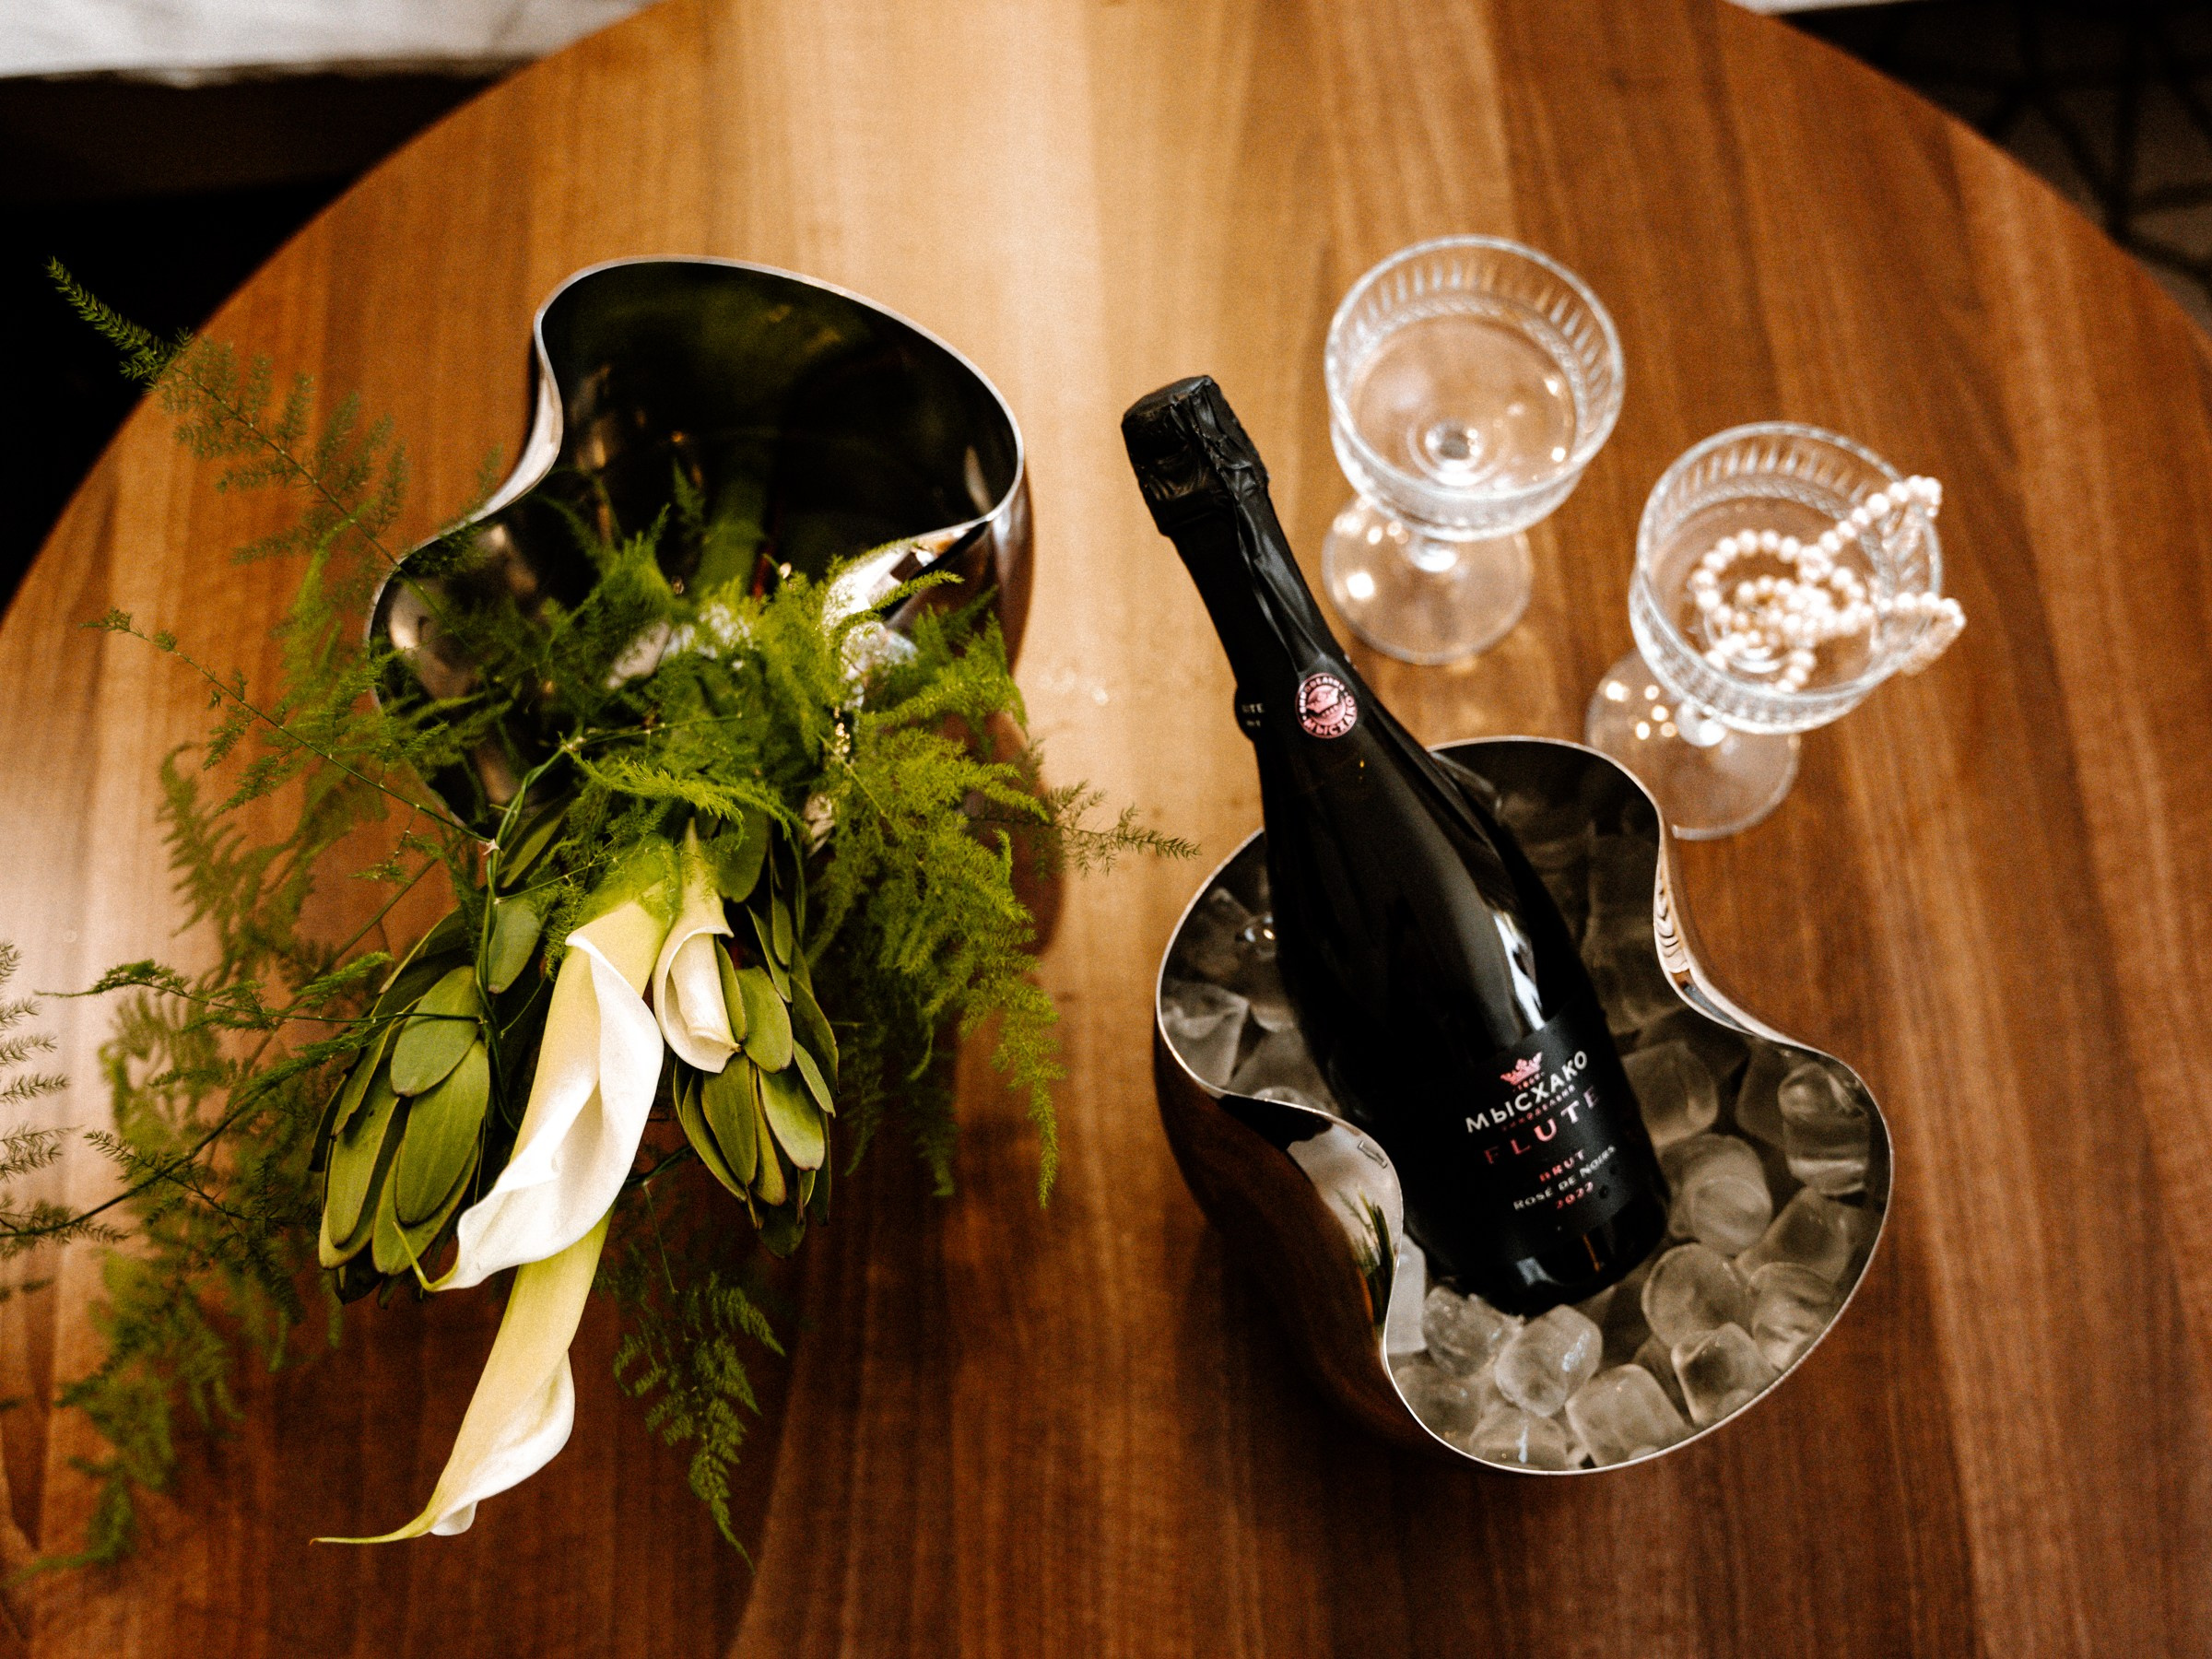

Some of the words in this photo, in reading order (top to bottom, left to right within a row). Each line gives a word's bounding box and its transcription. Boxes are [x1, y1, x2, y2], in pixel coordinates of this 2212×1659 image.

[1465, 1051, 1588, 1134] МЫСХАКО
[1484, 1086, 1599, 1165] FLUTE
[1539, 1149, 1584, 1183] BRUT
[1558, 1175, 1577, 1192] DE
